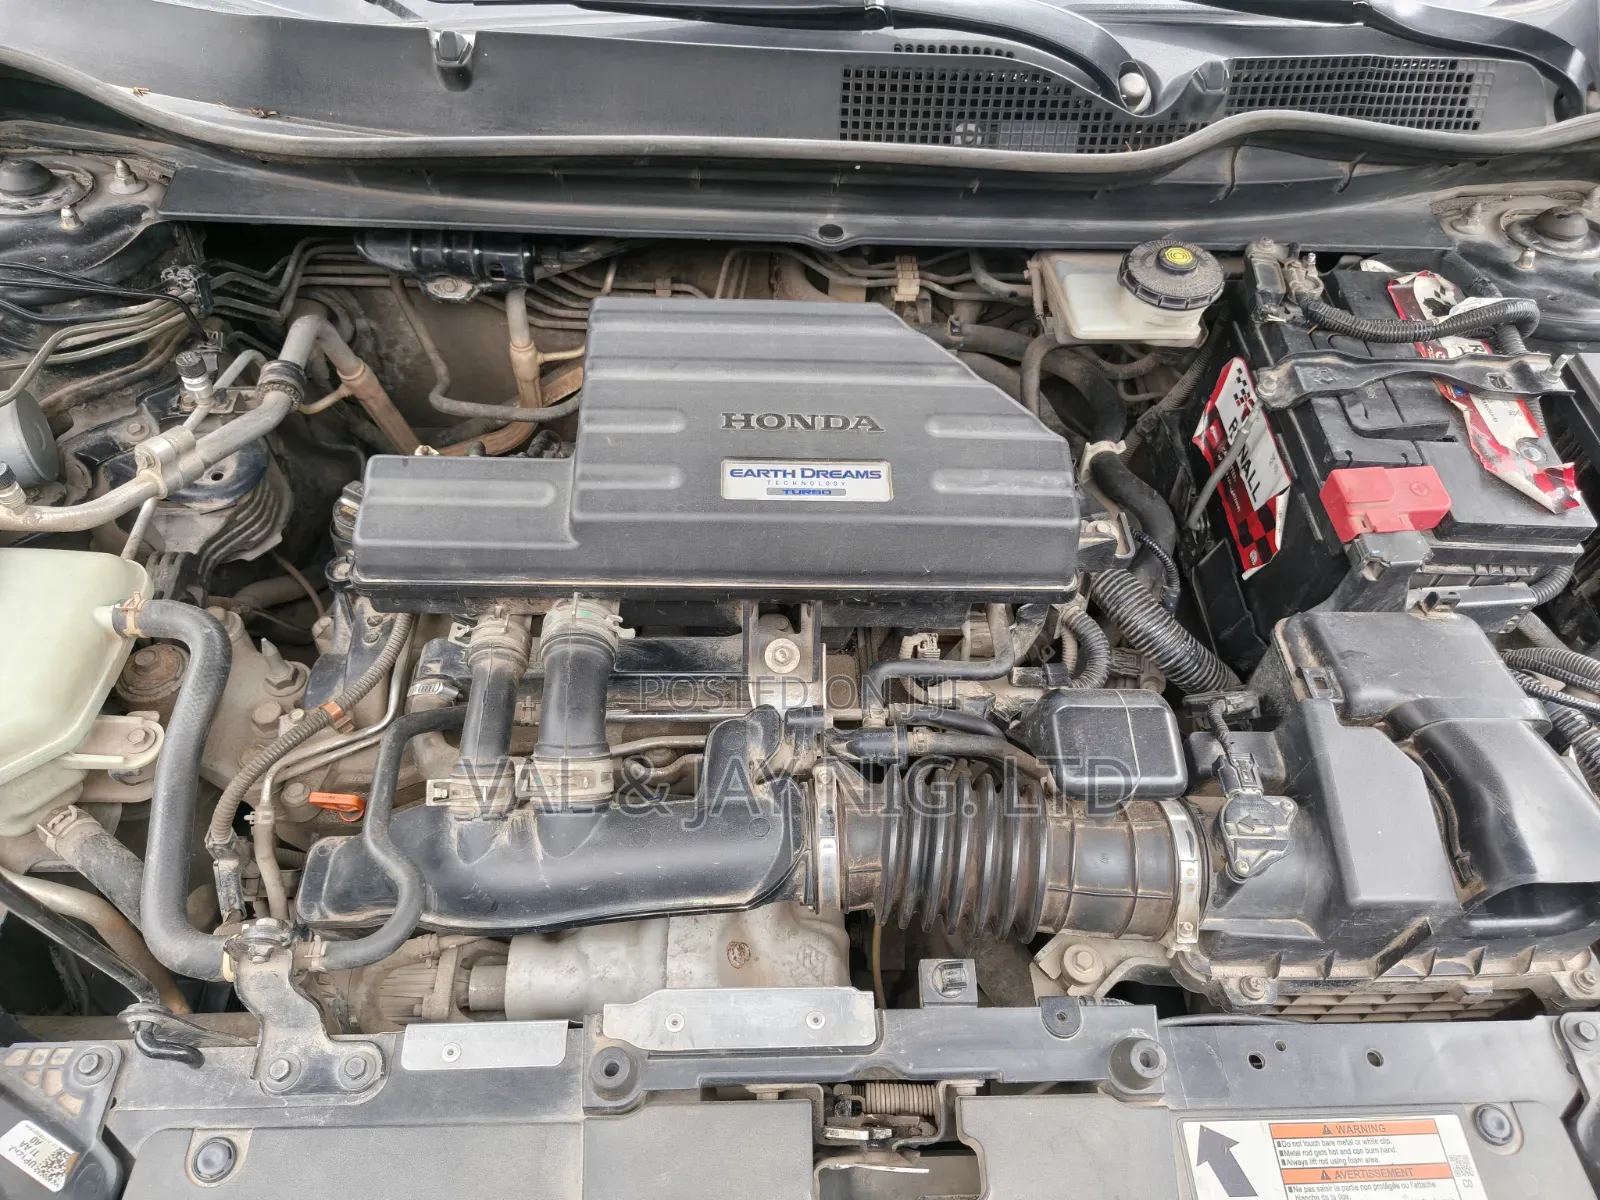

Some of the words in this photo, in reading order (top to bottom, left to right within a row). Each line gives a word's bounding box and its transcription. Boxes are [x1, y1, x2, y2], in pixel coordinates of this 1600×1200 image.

[721, 413, 885, 432] HONDA
[730, 468, 796, 478] EARTH
[801, 468, 882, 479] DREAMS
[1336, 1124, 1386, 1134] WARNING
[1281, 1140, 1291, 1148] Do
[1321, 1139, 1336, 1147] bare
[1336, 1138, 1354, 1146] metal
[1283, 1149, 1301, 1157] Metal
[1314, 1149, 1328, 1158] gets
[1328, 1148, 1339, 1156] hot
[1339, 1147, 1352, 1155] and
[1380, 1145, 1397, 1153] hand.
[1286, 1158, 1309, 1167] Always
[1330, 1157, 1347, 1166] using
[1334, 1168, 1414, 1180] AVERTISSEMENT
[1293, 1185, 1303, 1193] Ne
[1303, 1186, 1316, 1194] pas
[1360, 1183, 1372, 1191] non
